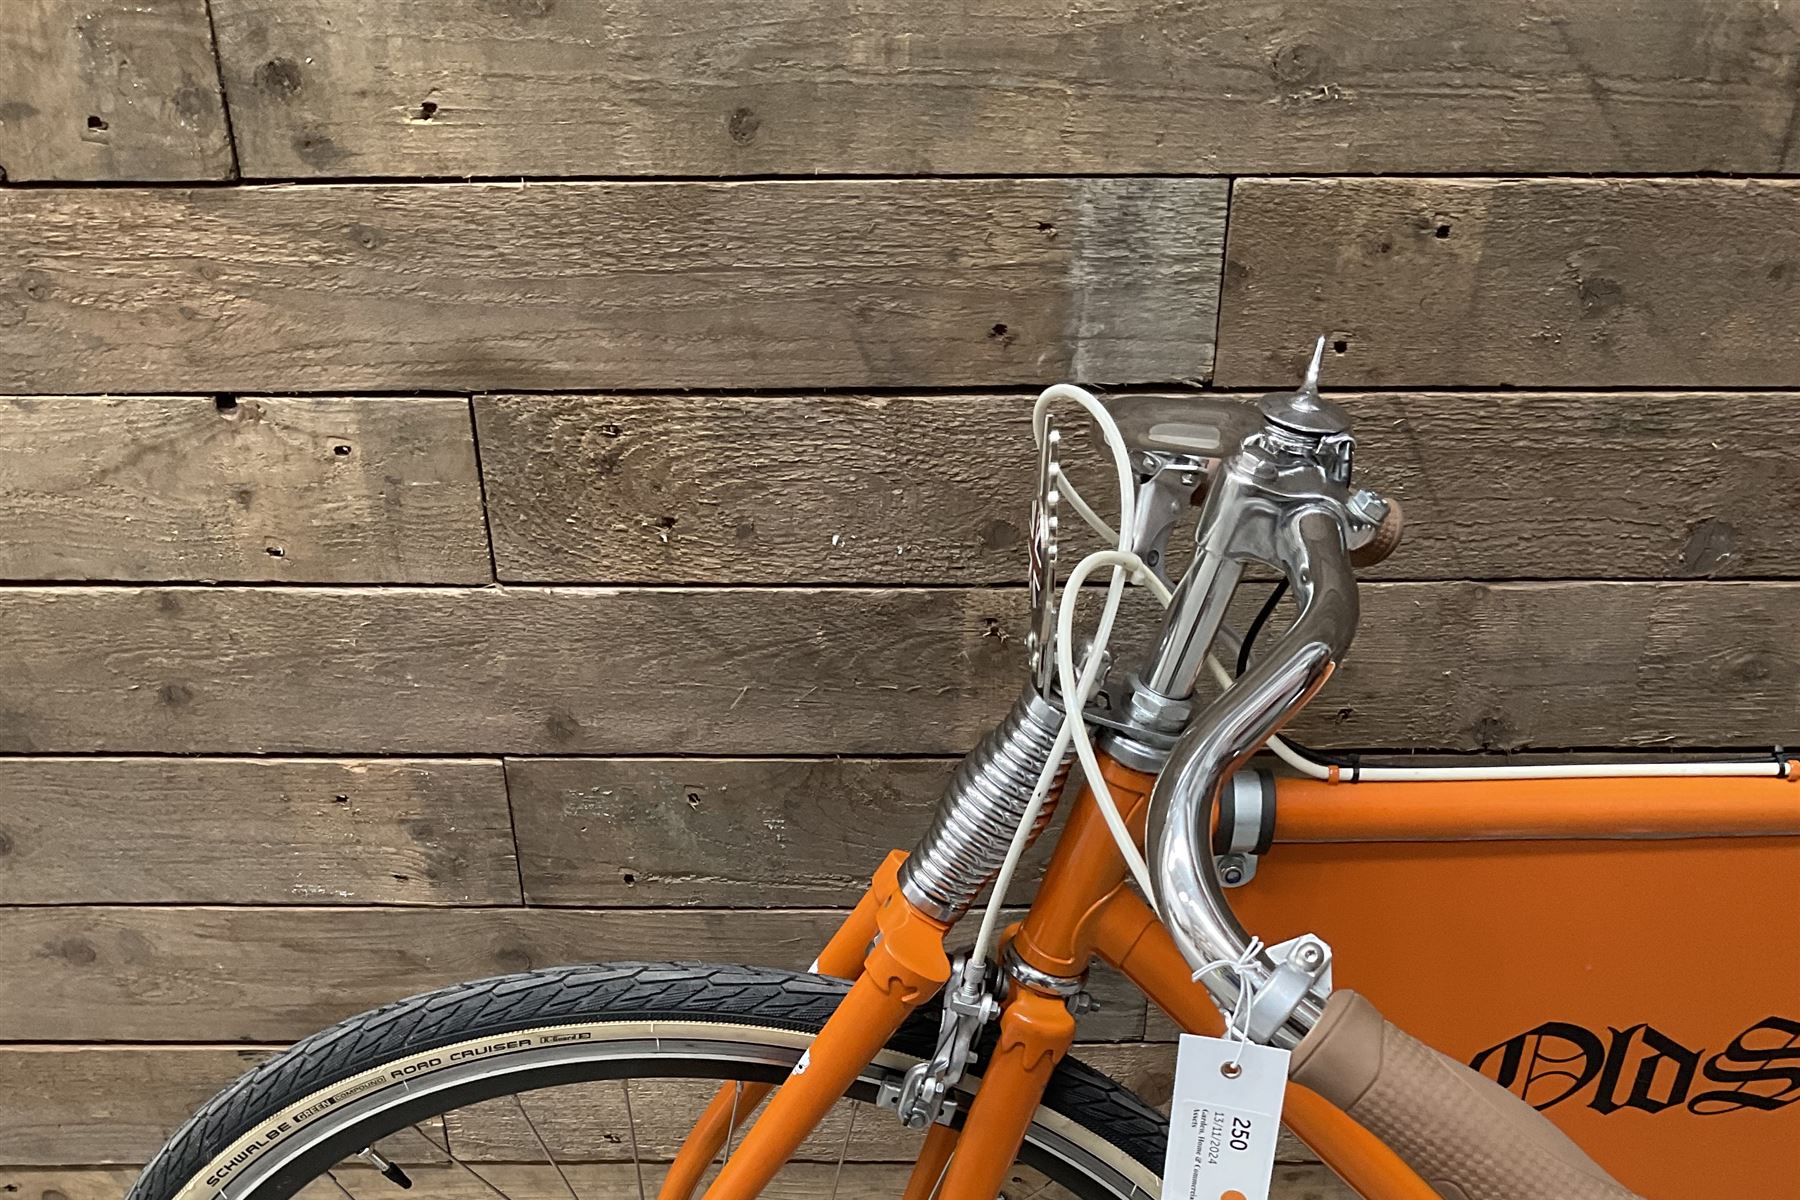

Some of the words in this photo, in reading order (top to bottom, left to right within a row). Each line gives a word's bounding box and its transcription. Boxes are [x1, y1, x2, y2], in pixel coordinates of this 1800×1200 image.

[206, 1122, 292, 1187] SCHWALBE
[297, 1100, 331, 1121] GREEN
[334, 1077, 385, 1101] COMPOUND
[391, 1058, 442, 1079] ROAD
[450, 1039, 531, 1061] CRUISER
[1191, 1108, 1200, 1128] Assets
[1199, 1108, 1209, 1135] Garden,
[1197, 1135, 1205, 1155] Home
[1208, 1111, 1225, 1165] 13/11/2024
[1229, 1117, 1251, 1151] 250
